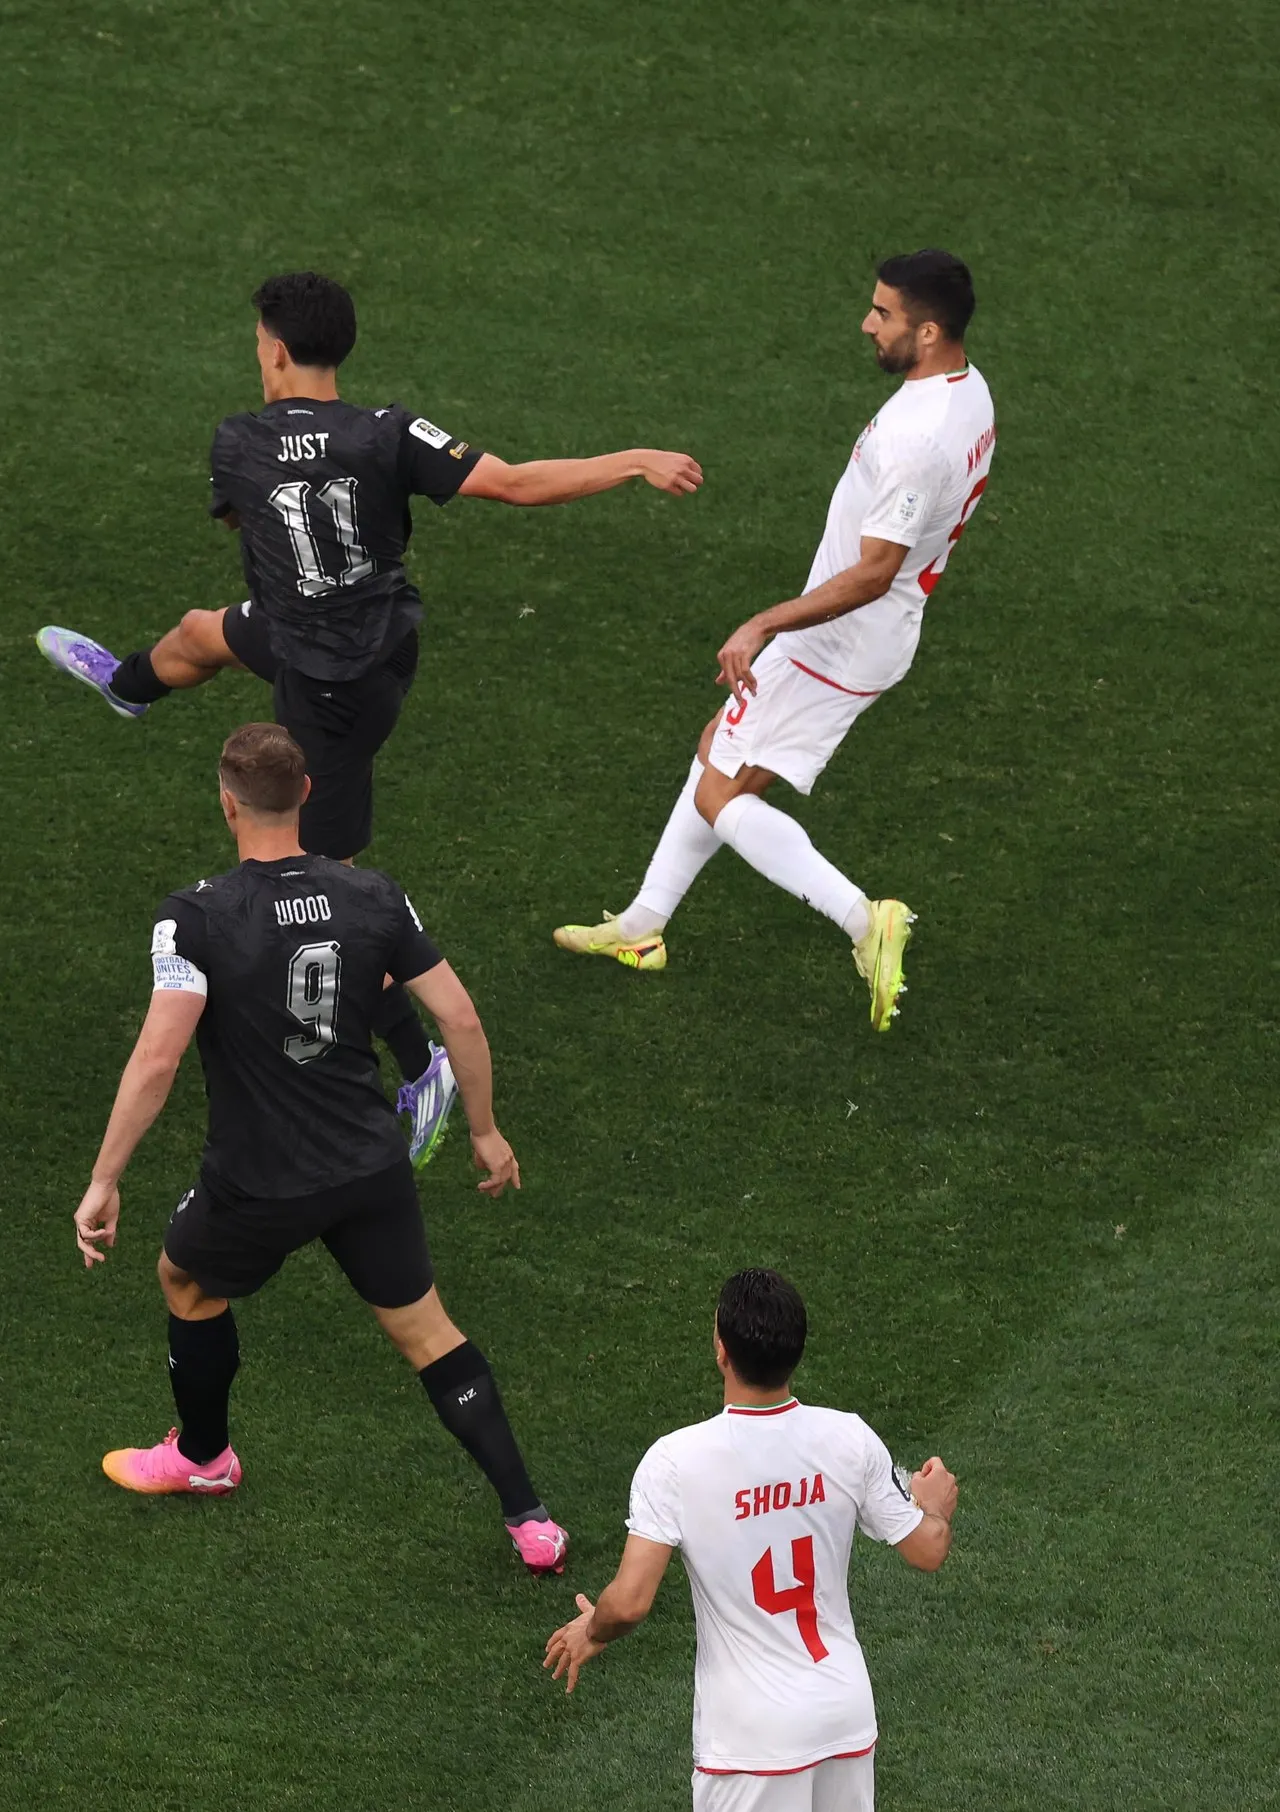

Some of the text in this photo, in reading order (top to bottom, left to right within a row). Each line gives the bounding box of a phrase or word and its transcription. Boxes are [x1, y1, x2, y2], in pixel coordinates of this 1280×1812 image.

[277, 432, 329, 462] JUST
[267, 476, 378, 598] 11
[274, 894, 332, 926] WOOD
[156, 964, 191, 974] UNITES
[283, 940, 342, 1065] 9
[458, 1387, 477, 1405] NZ
[735, 1473, 826, 1521] SHOJA
[751, 1535, 830, 1663] 4
